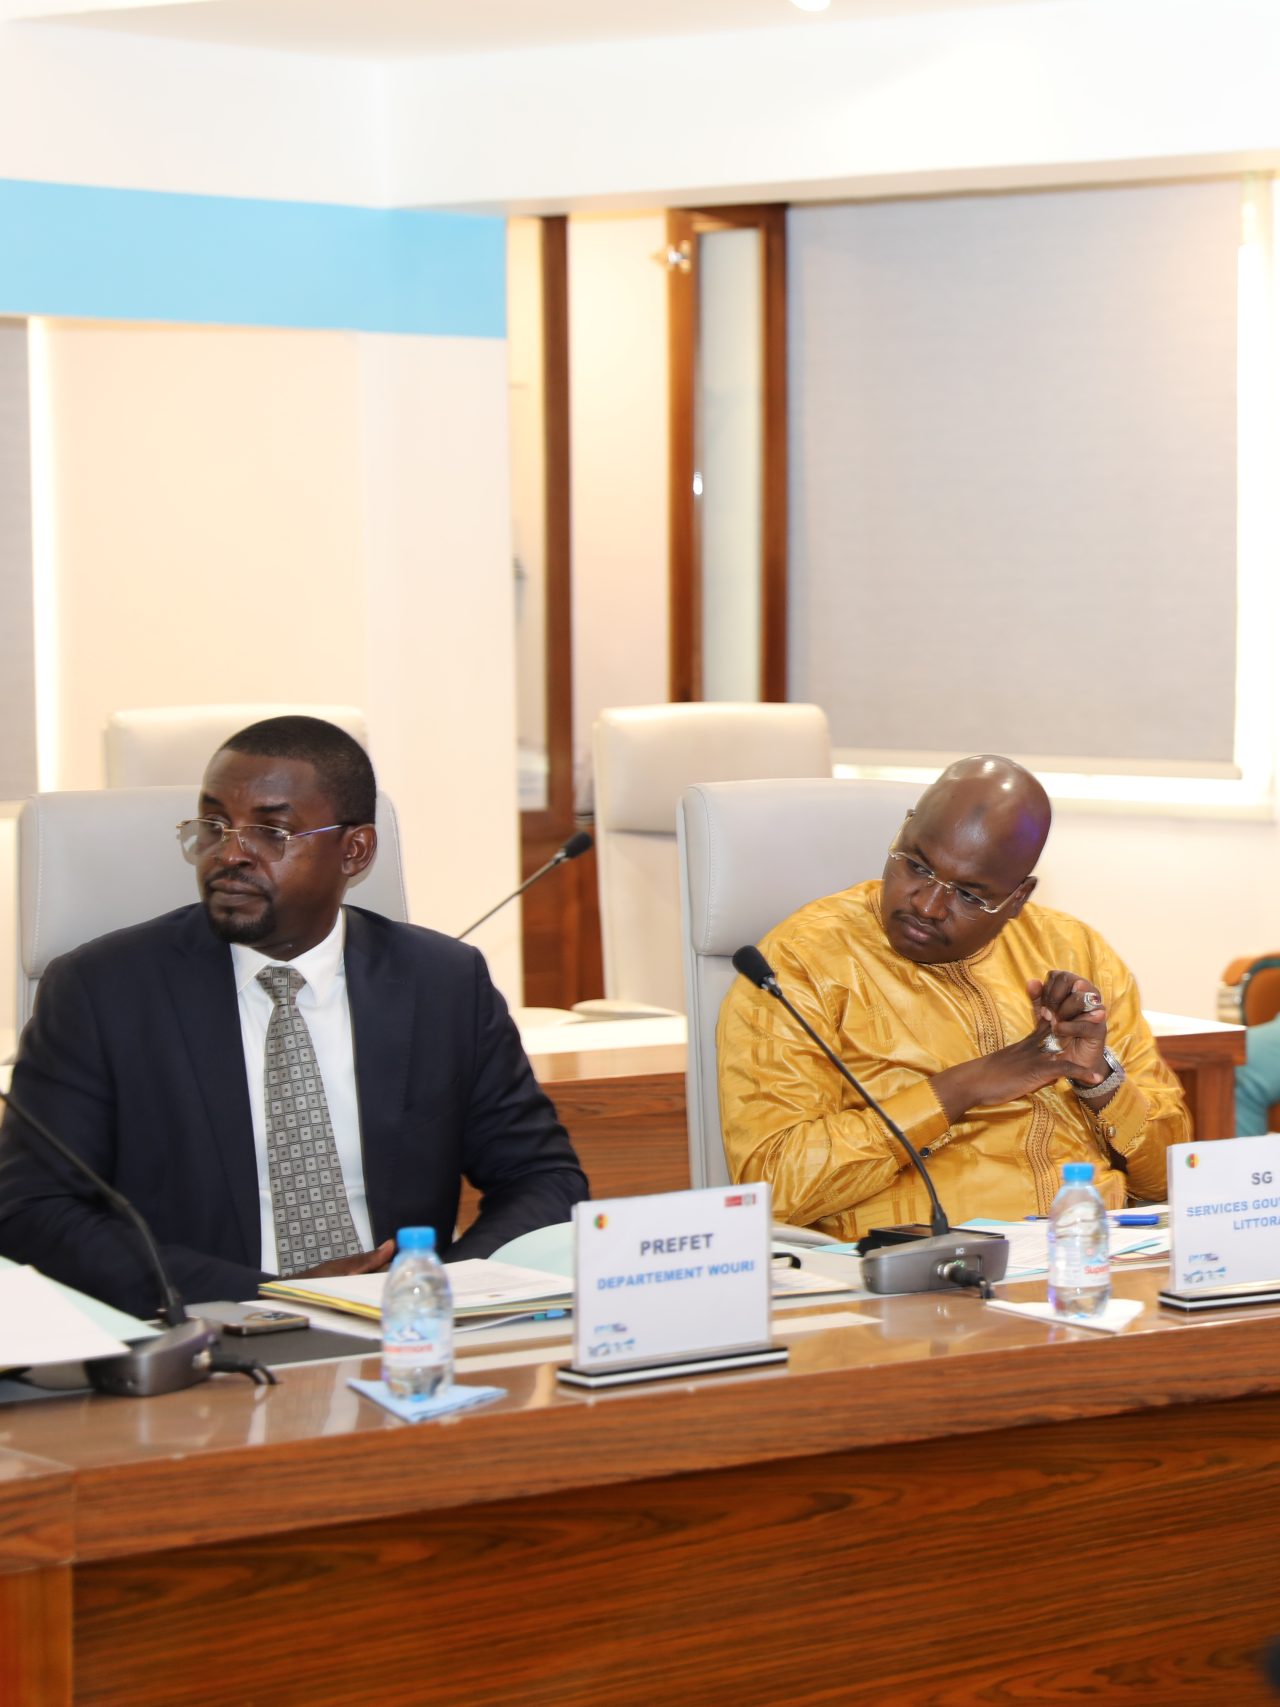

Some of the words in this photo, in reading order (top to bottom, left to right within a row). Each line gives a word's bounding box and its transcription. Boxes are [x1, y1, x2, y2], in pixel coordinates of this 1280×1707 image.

[1251, 1171, 1273, 1186] SG
[1186, 1201, 1248, 1217] SERVICES
[640, 1233, 714, 1256] PREFET
[597, 1266, 703, 1290] DEPARTEMENT
[708, 1260, 755, 1277] WOURI
